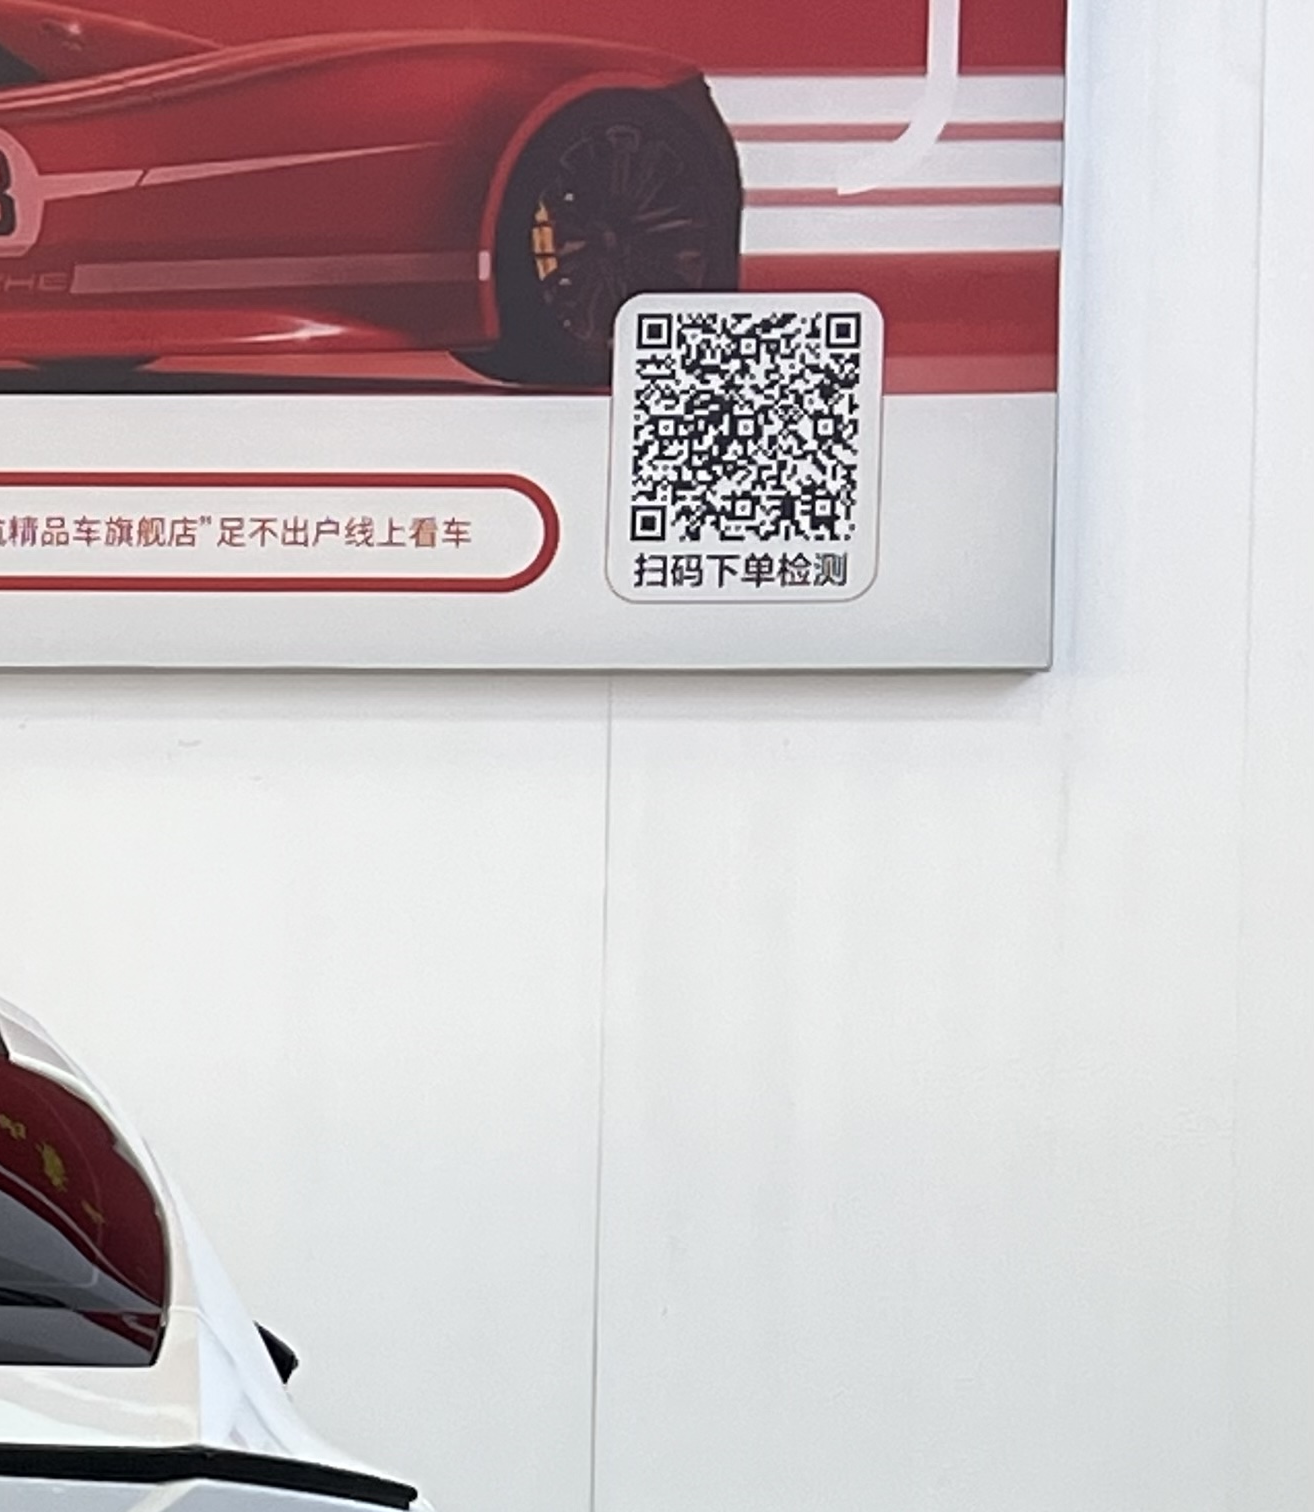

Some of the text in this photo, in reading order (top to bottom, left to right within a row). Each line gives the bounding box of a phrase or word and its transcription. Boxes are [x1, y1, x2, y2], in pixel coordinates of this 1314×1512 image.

[633, 552, 849, 589] 扫码下单检测
